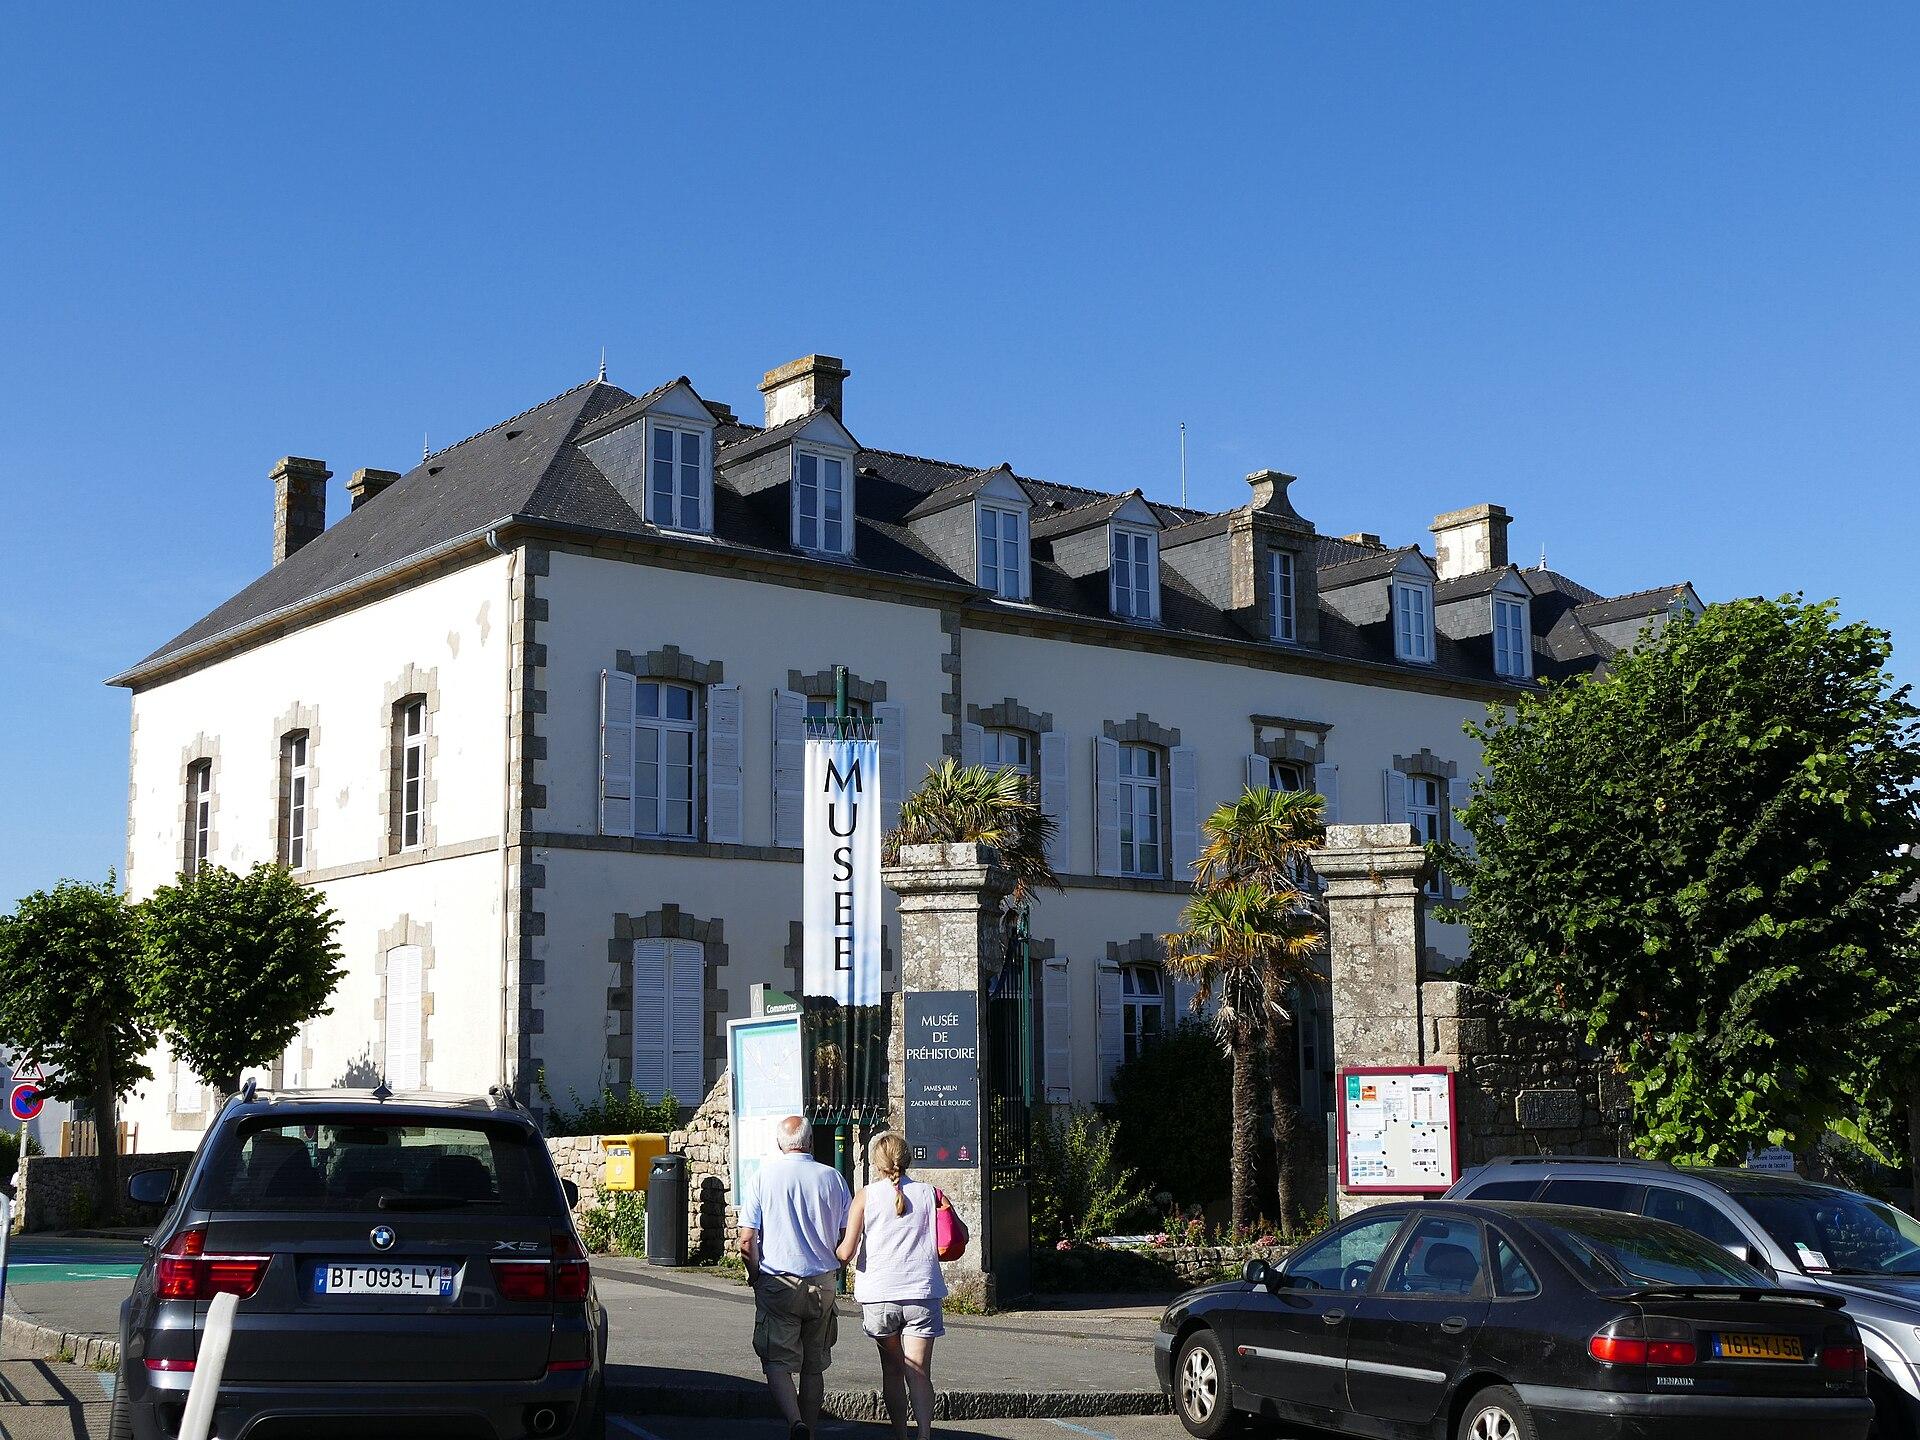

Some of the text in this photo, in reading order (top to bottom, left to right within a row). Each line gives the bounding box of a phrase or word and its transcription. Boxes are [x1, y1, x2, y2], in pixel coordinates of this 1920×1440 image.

[824, 758, 863, 971] MUSEE
[766, 1003, 798, 1014] Commerces
[921, 1012, 959, 1027] MUSÉE
[932, 1031, 949, 1043] DE
[906, 1045, 975, 1060] PRÉHISTOIRE
[923, 1084, 942, 1092] JAMES
[940, 1099, 947, 1107] LE
[492, 1240, 539, 1251] X5
[331, 1267, 438, 1289] BT-093-LY
[441, 1280, 451, 1290] 77
[1724, 1335, 1761, 1355] 1615
[1783, 1338, 1801, 1356] 56
[1656, 1376, 1695, 1386] RENAULT
